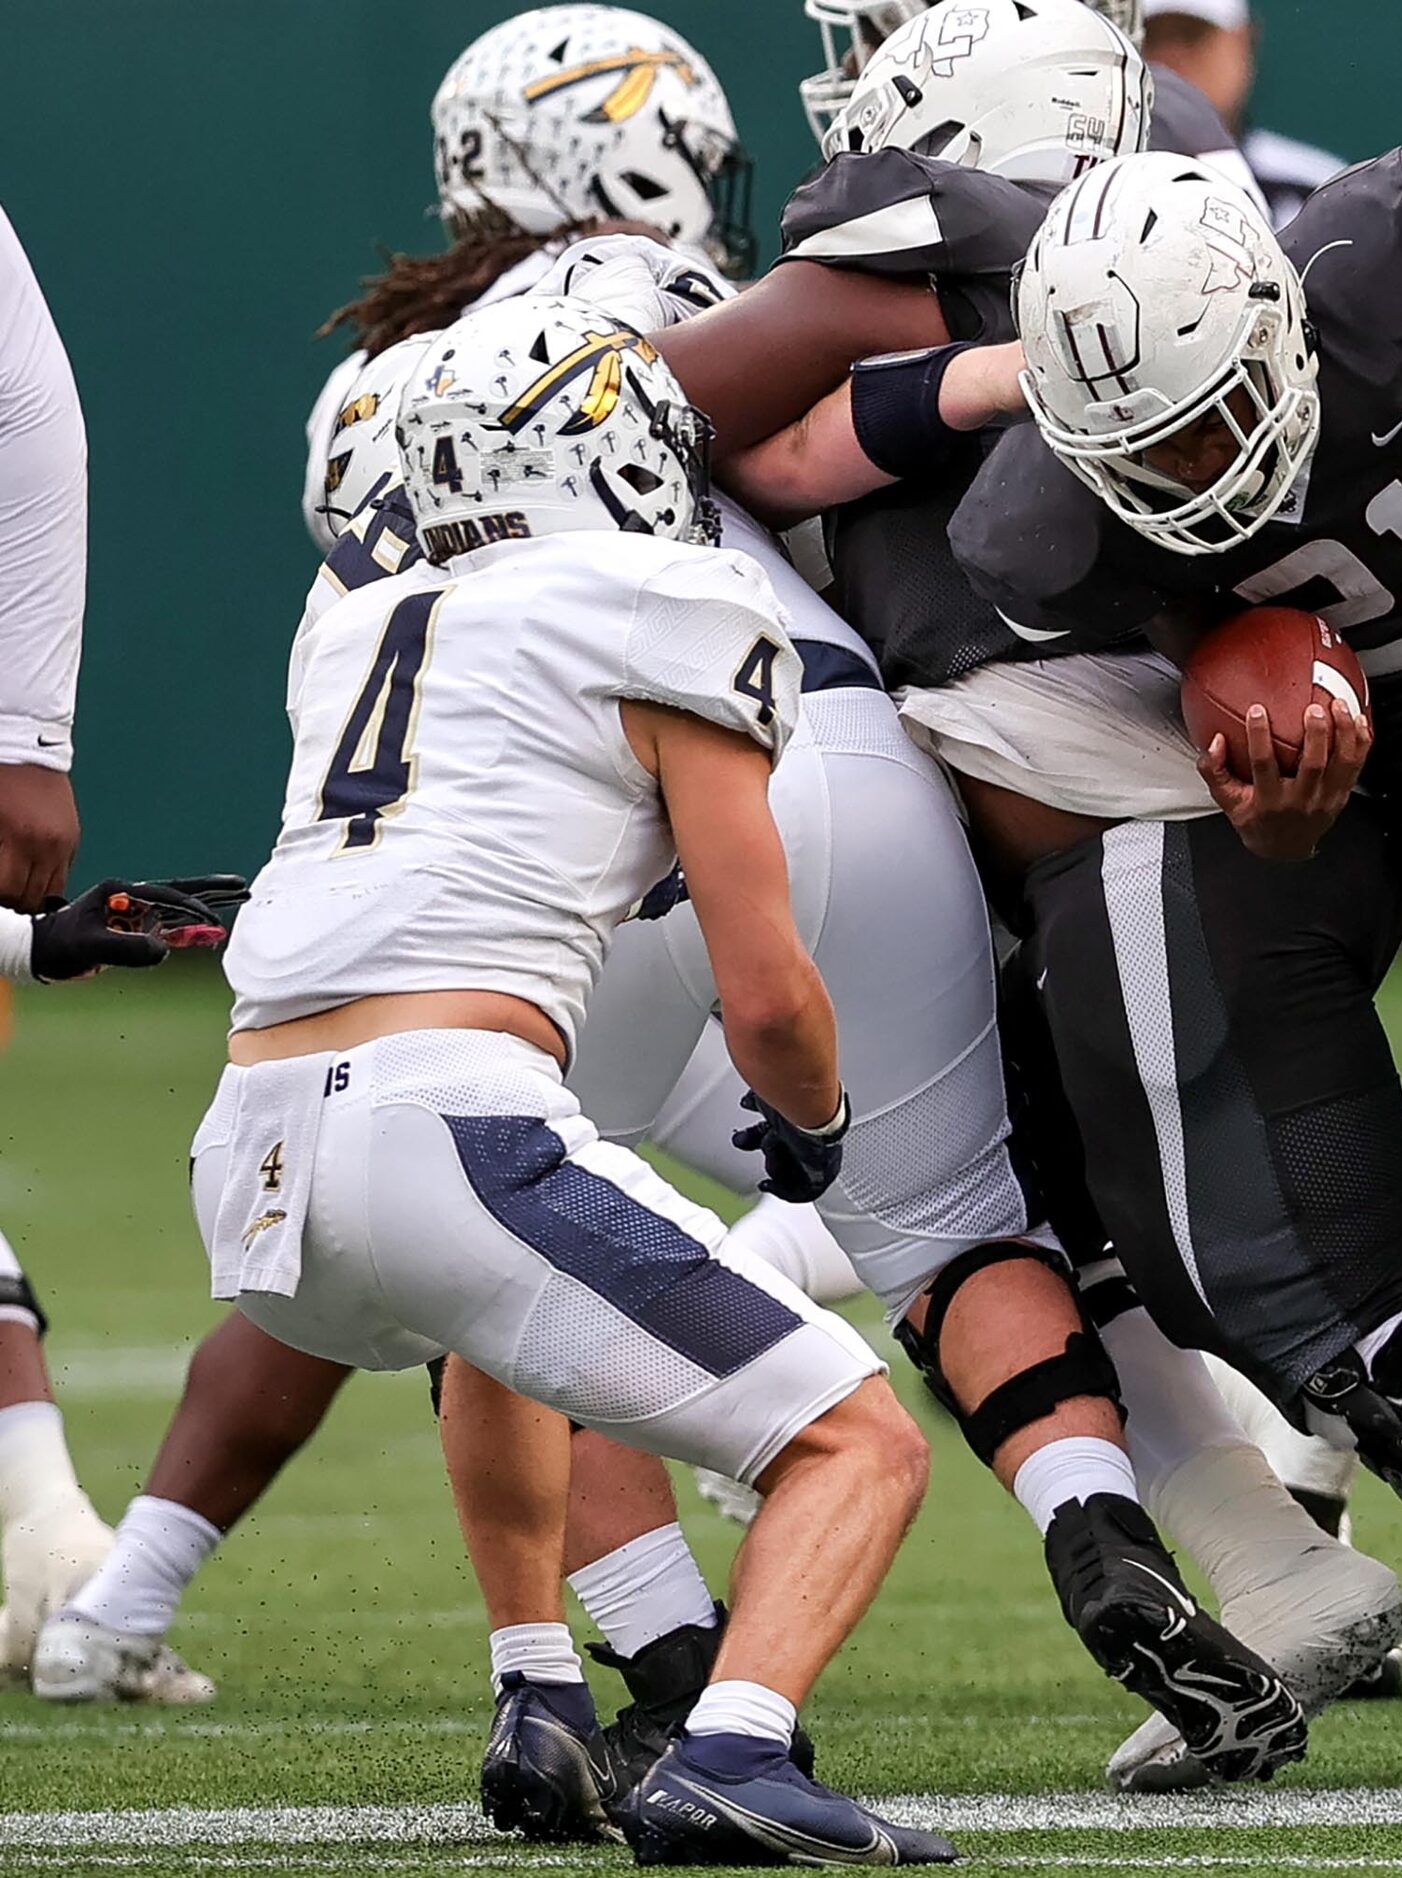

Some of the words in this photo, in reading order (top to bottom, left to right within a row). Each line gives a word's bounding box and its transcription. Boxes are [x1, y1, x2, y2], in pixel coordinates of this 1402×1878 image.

[431, 435, 464, 494] 4
[422, 511, 532, 559] INDIANS
[730, 632, 784, 726] 4
[311, 584, 455, 859] 4
[258, 1138, 286, 1193] 4
